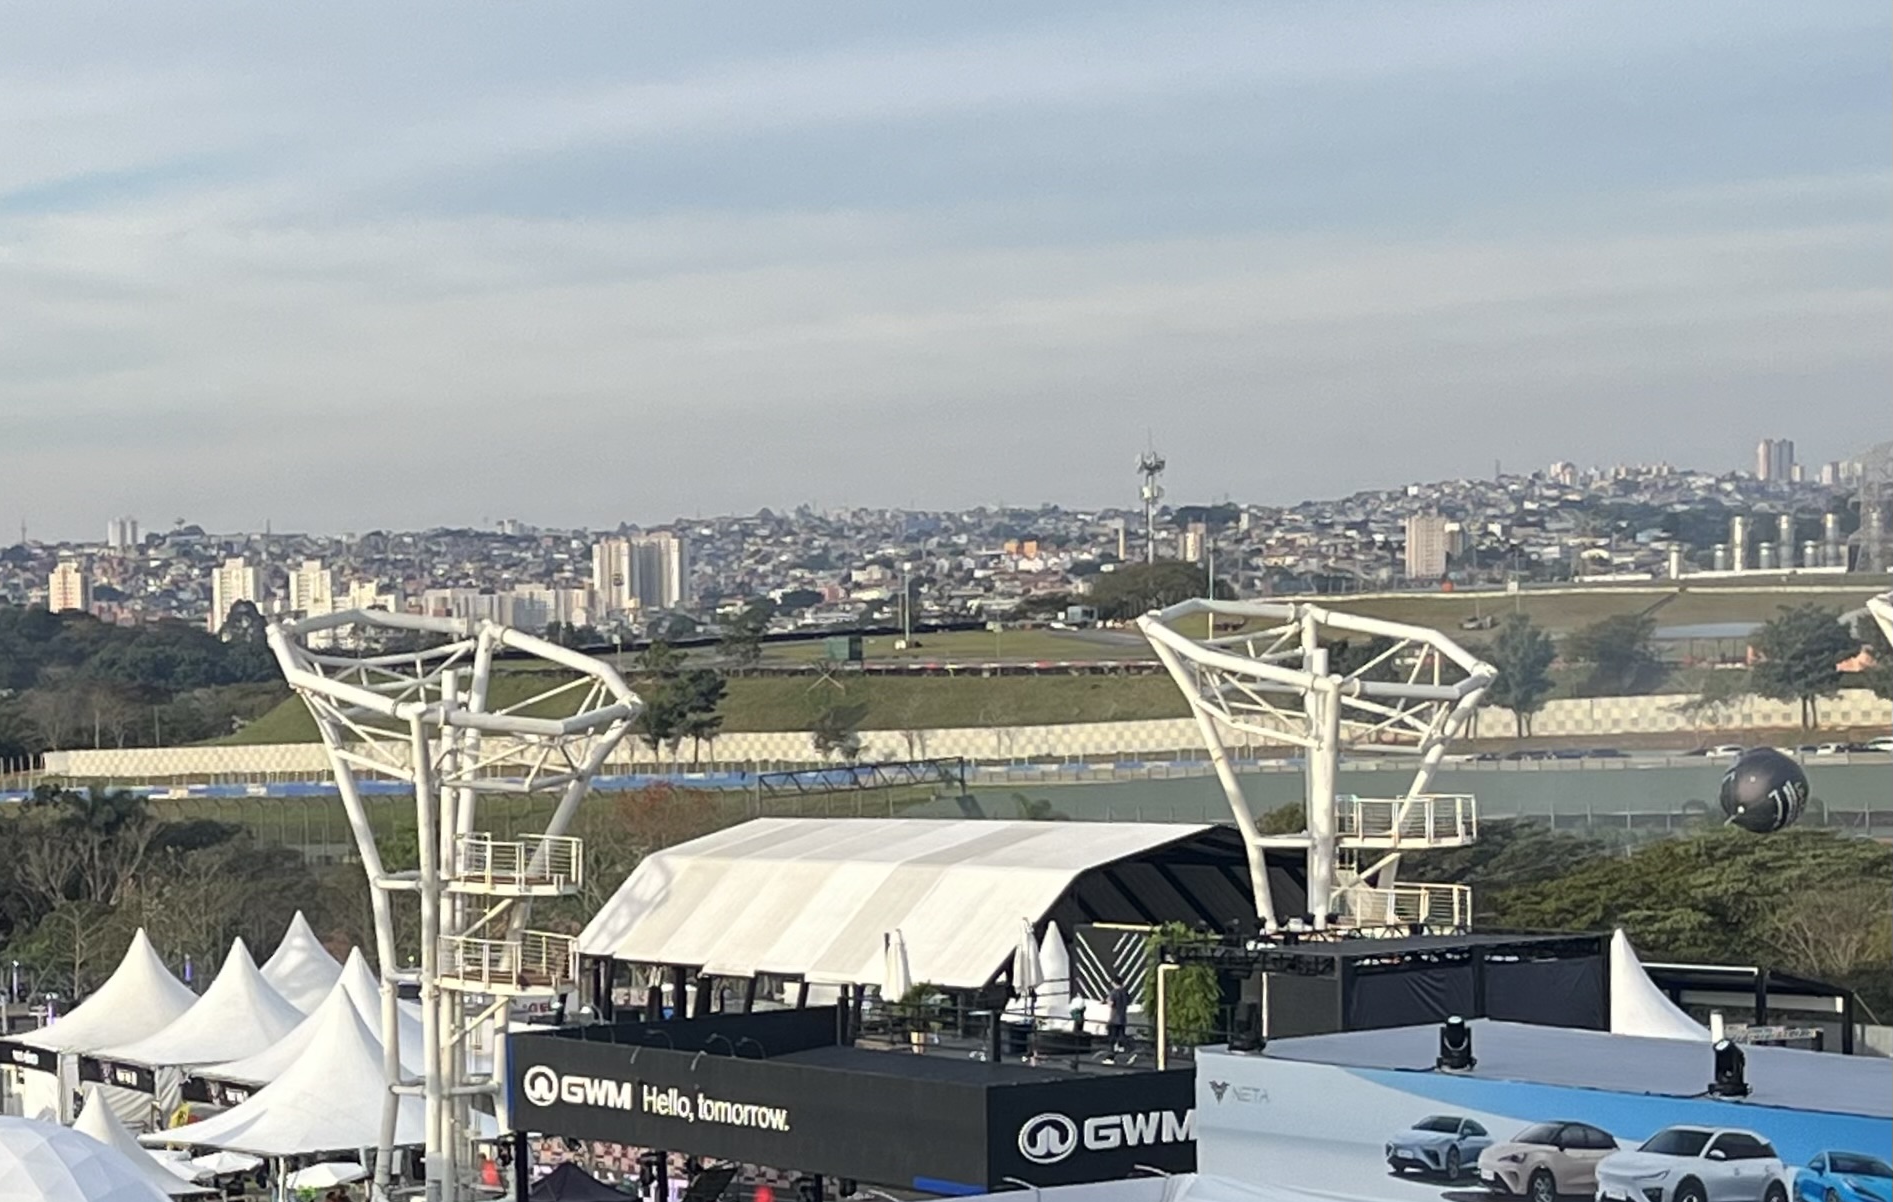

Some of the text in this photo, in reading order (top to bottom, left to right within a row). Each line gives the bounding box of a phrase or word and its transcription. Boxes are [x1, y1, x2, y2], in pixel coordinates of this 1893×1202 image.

[561, 1075, 790, 1131] GWM Hello, tomorrow.
[1084, 1108, 1198, 1150] GWM
